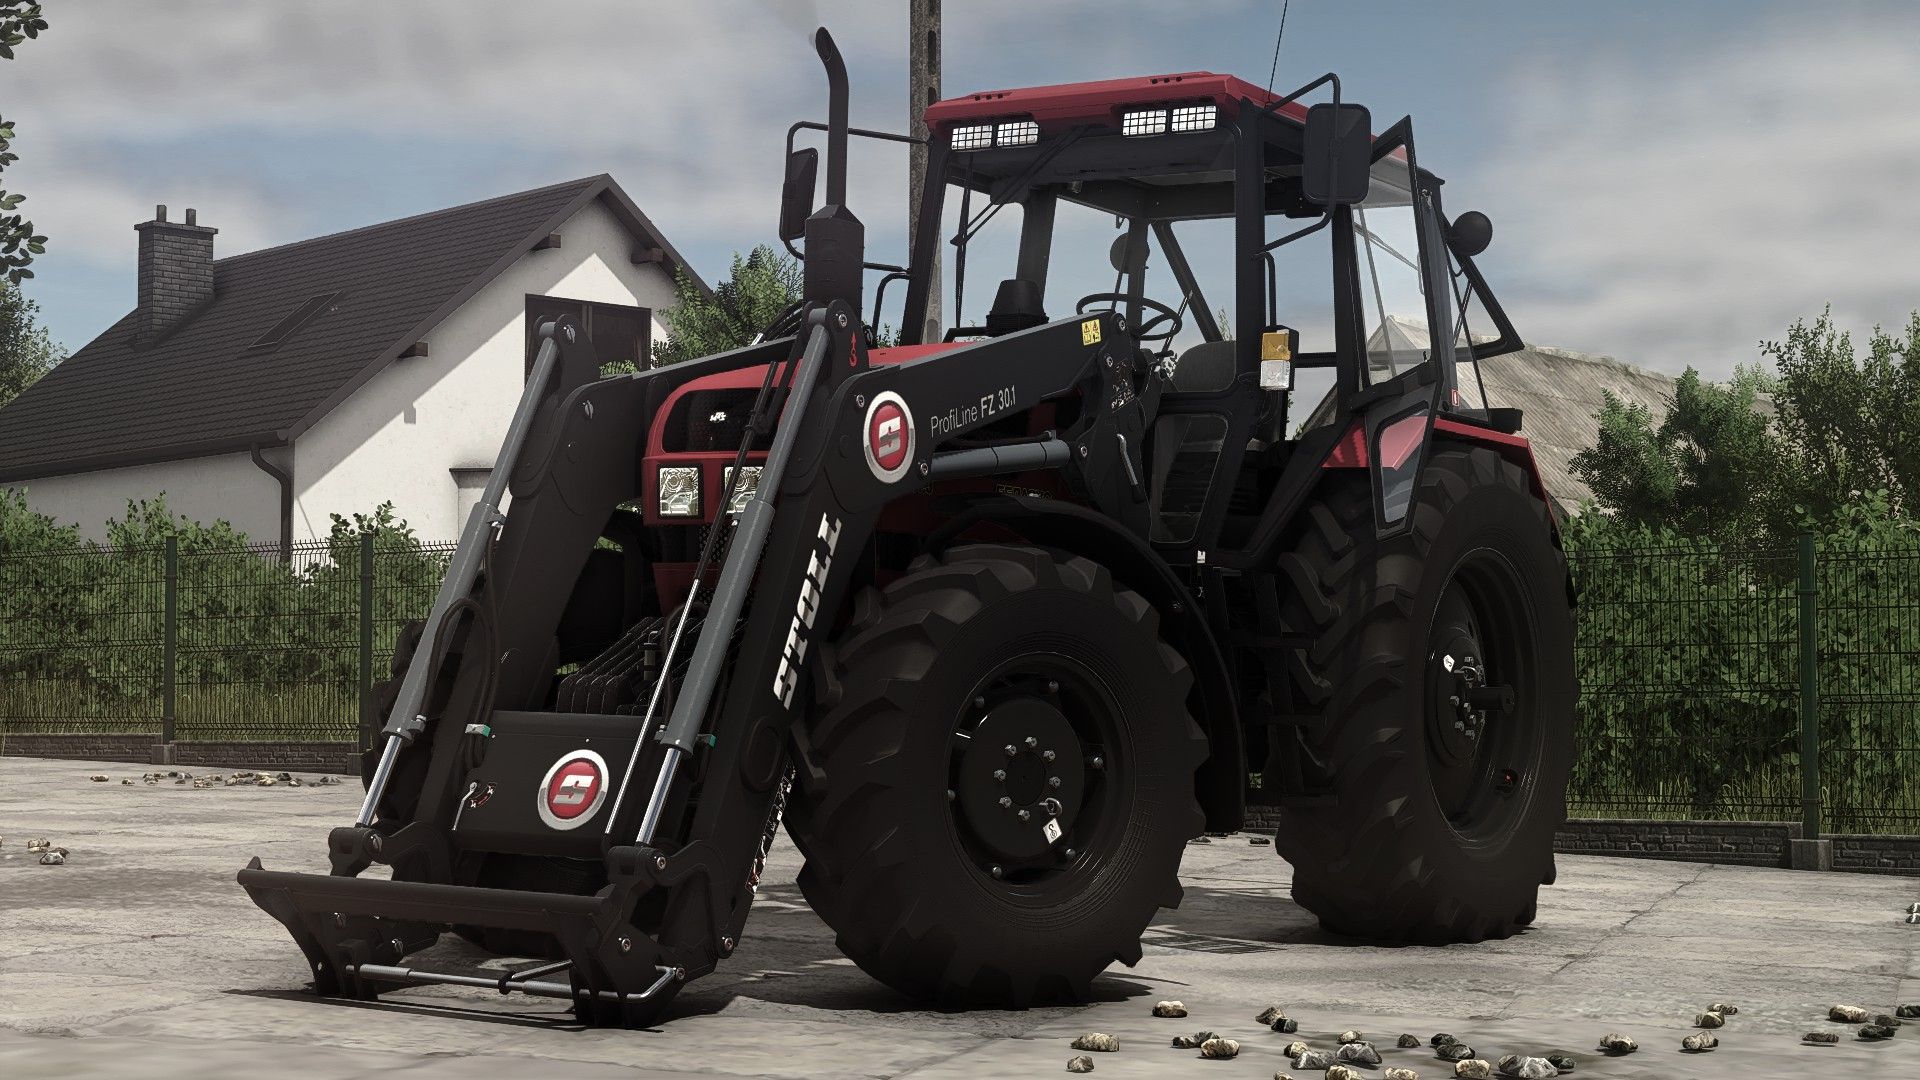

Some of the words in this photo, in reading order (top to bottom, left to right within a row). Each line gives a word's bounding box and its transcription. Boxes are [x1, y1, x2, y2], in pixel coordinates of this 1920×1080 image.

[930, 404, 978, 438] ProfiLine
[980, 395, 995, 418] FZ
[998, 385, 1016, 410] 30.1
[773, 512, 842, 711] STOLL
